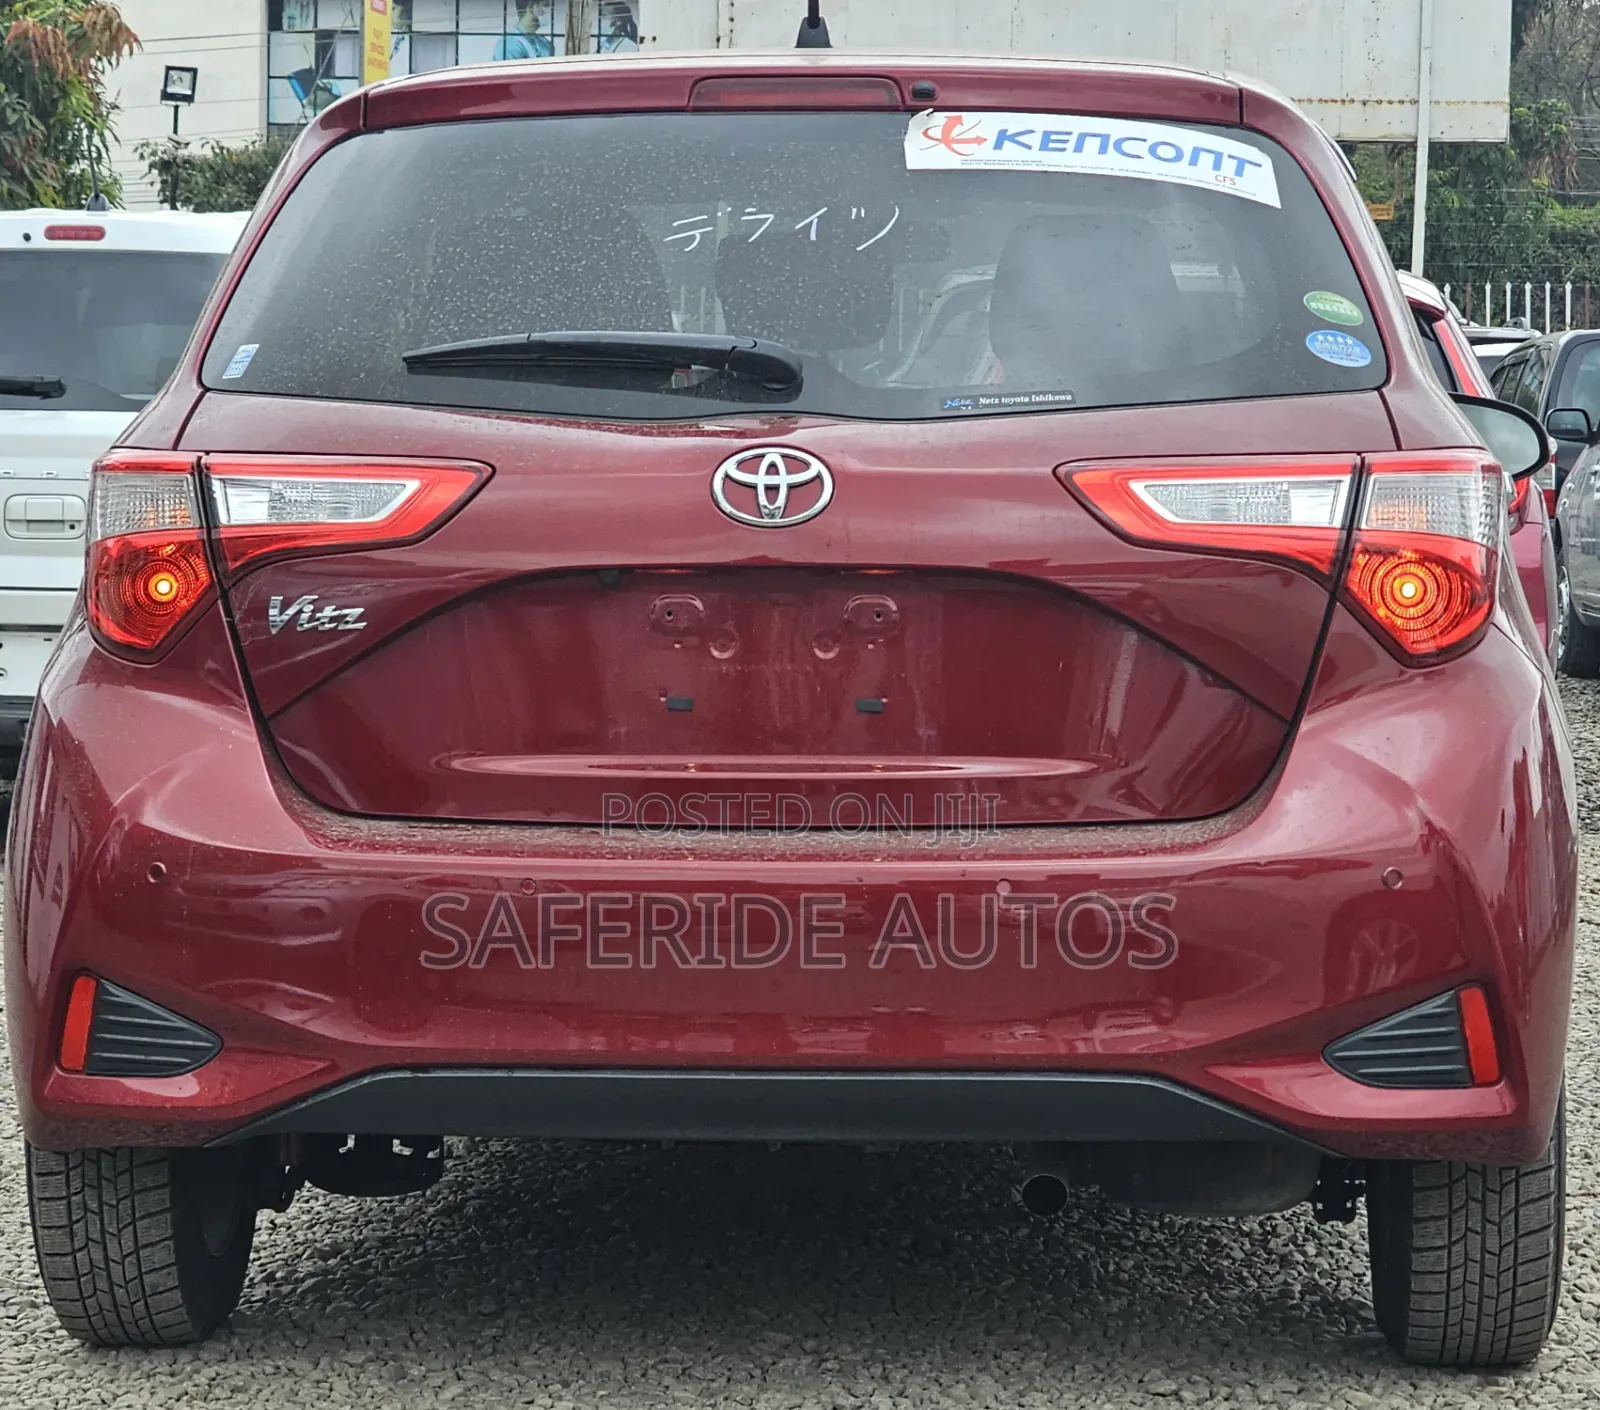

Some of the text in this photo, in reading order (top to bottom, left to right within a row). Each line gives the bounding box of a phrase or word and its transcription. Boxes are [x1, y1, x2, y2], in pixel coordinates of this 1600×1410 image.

[1214, 174, 1237, 186] CFS
[1031, 393, 1073, 403] Ishikawa
[268, 595, 368, 635] Vitz
